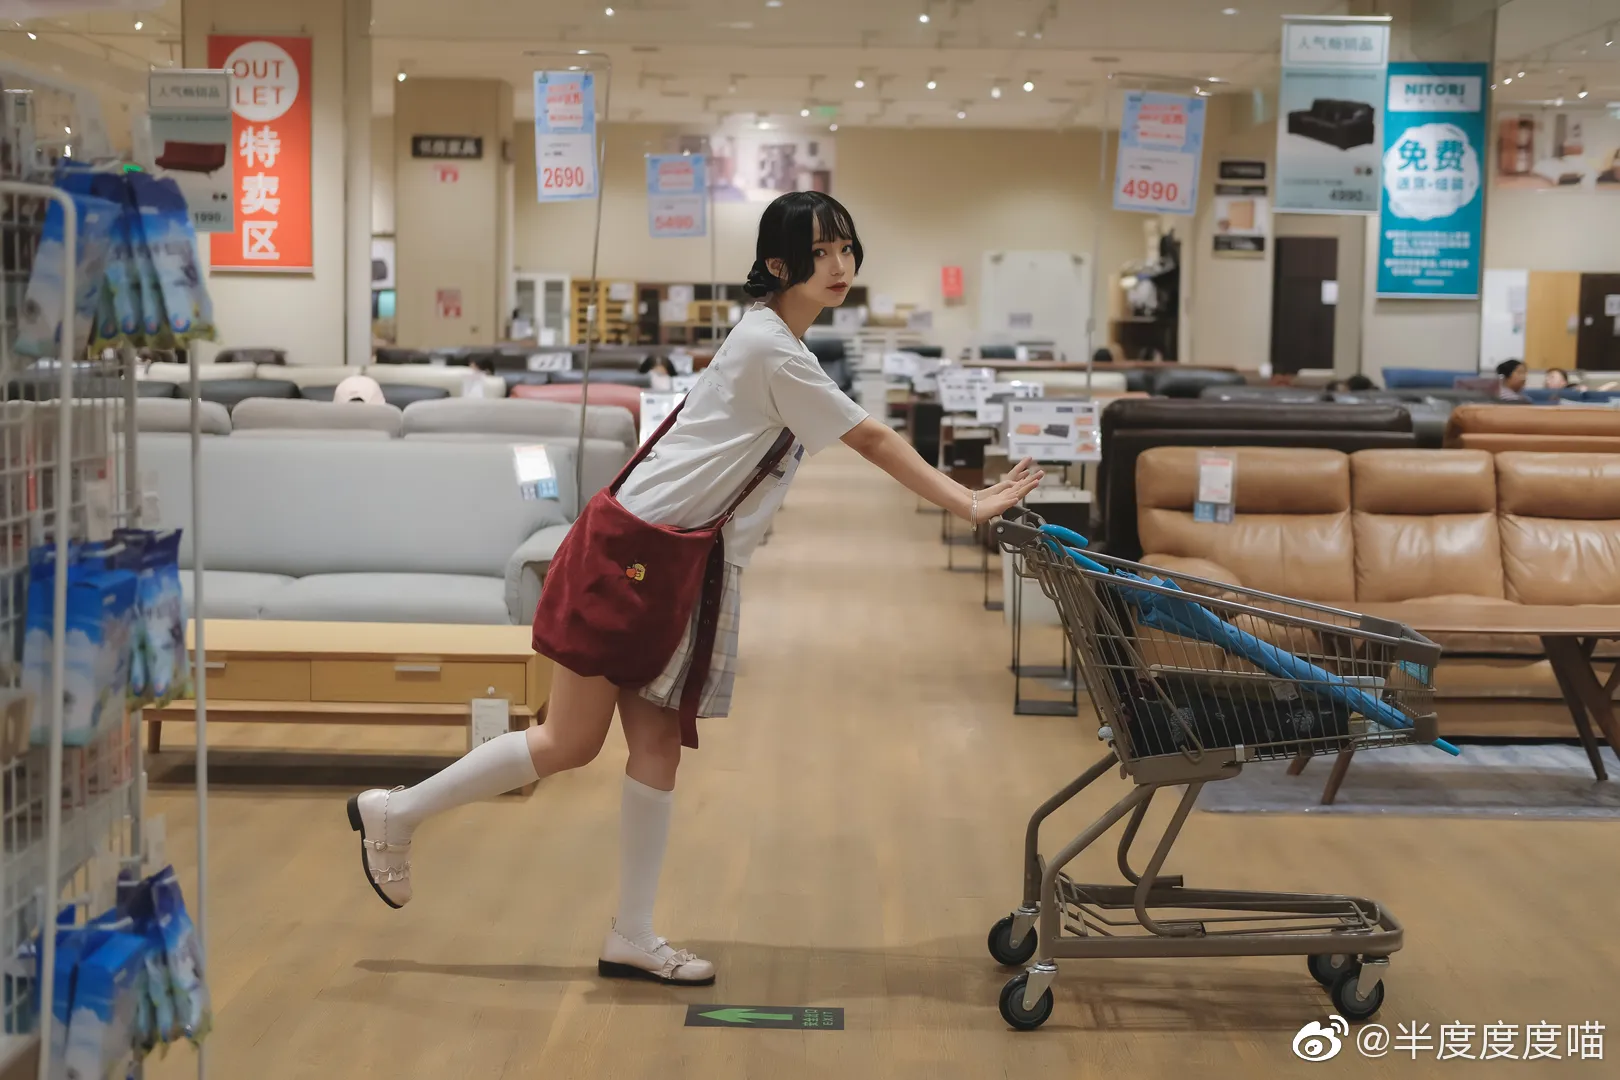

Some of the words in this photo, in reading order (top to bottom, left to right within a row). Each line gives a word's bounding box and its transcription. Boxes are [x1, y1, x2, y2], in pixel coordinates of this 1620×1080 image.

[232, 59, 286, 80] OUT
[235, 86, 286, 106] LET
[1405, 83, 1466, 96] NITORI
[1396, 139, 1466, 172] 免费
[543, 167, 585, 188] 2690
[239, 125, 281, 260] 特卖区
[1122, 179, 1179, 202] 4990
[823, 1012, 834, 1026] EXIT
